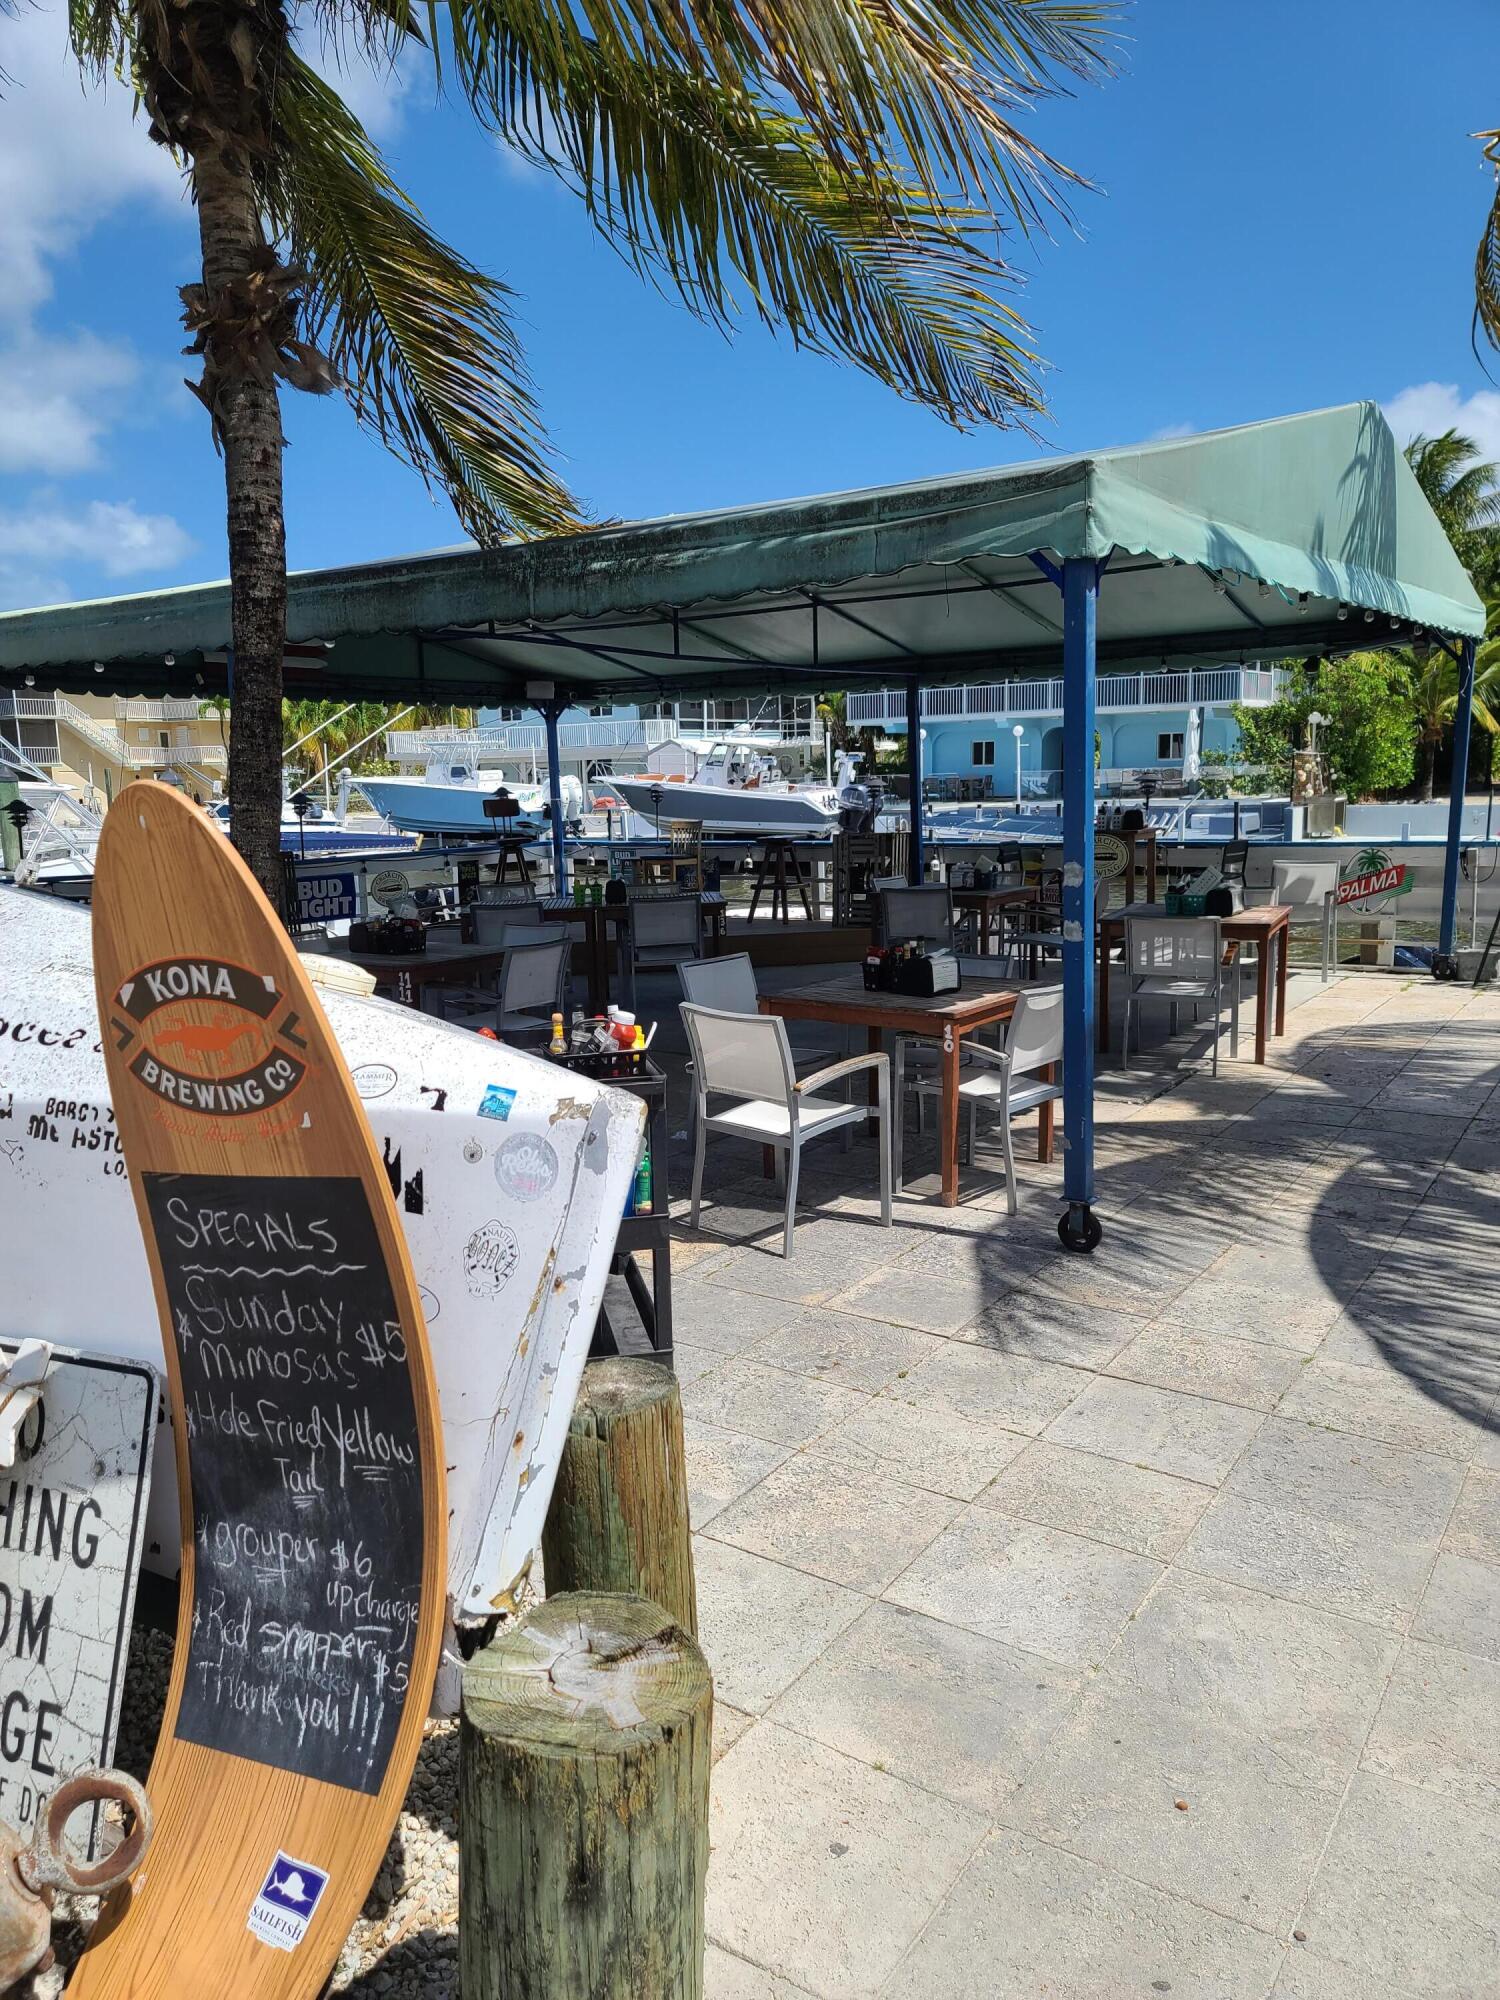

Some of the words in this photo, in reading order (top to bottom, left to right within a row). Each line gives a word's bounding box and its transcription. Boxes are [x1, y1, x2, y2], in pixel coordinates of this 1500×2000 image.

[297, 879, 343, 900] BUD
[301, 896, 353, 919] IGHT
[1339, 869, 1398, 899] PALMA
[144, 964, 236, 1002] KONA
[141, 1058, 265, 1111] BREWING
[166, 1197, 338, 1253] SPECIALS
[185, 1275, 344, 1345] Sunday
[355, 1320, 408, 1369] $5
[256, 1398, 326, 1449] Fried
[322, 1403, 414, 1487] Yellow
[273, 1450, 325, 1493] Tail
[213, 1521, 318, 1587] grouper
[329, 1540, 372, 1578] $6
[206, 1589, 251, 1652] Red
[372, 1649, 409, 1696] $5
[194, 1648, 284, 1726] Thank
[251, 1904, 302, 1941] SAILFISH
